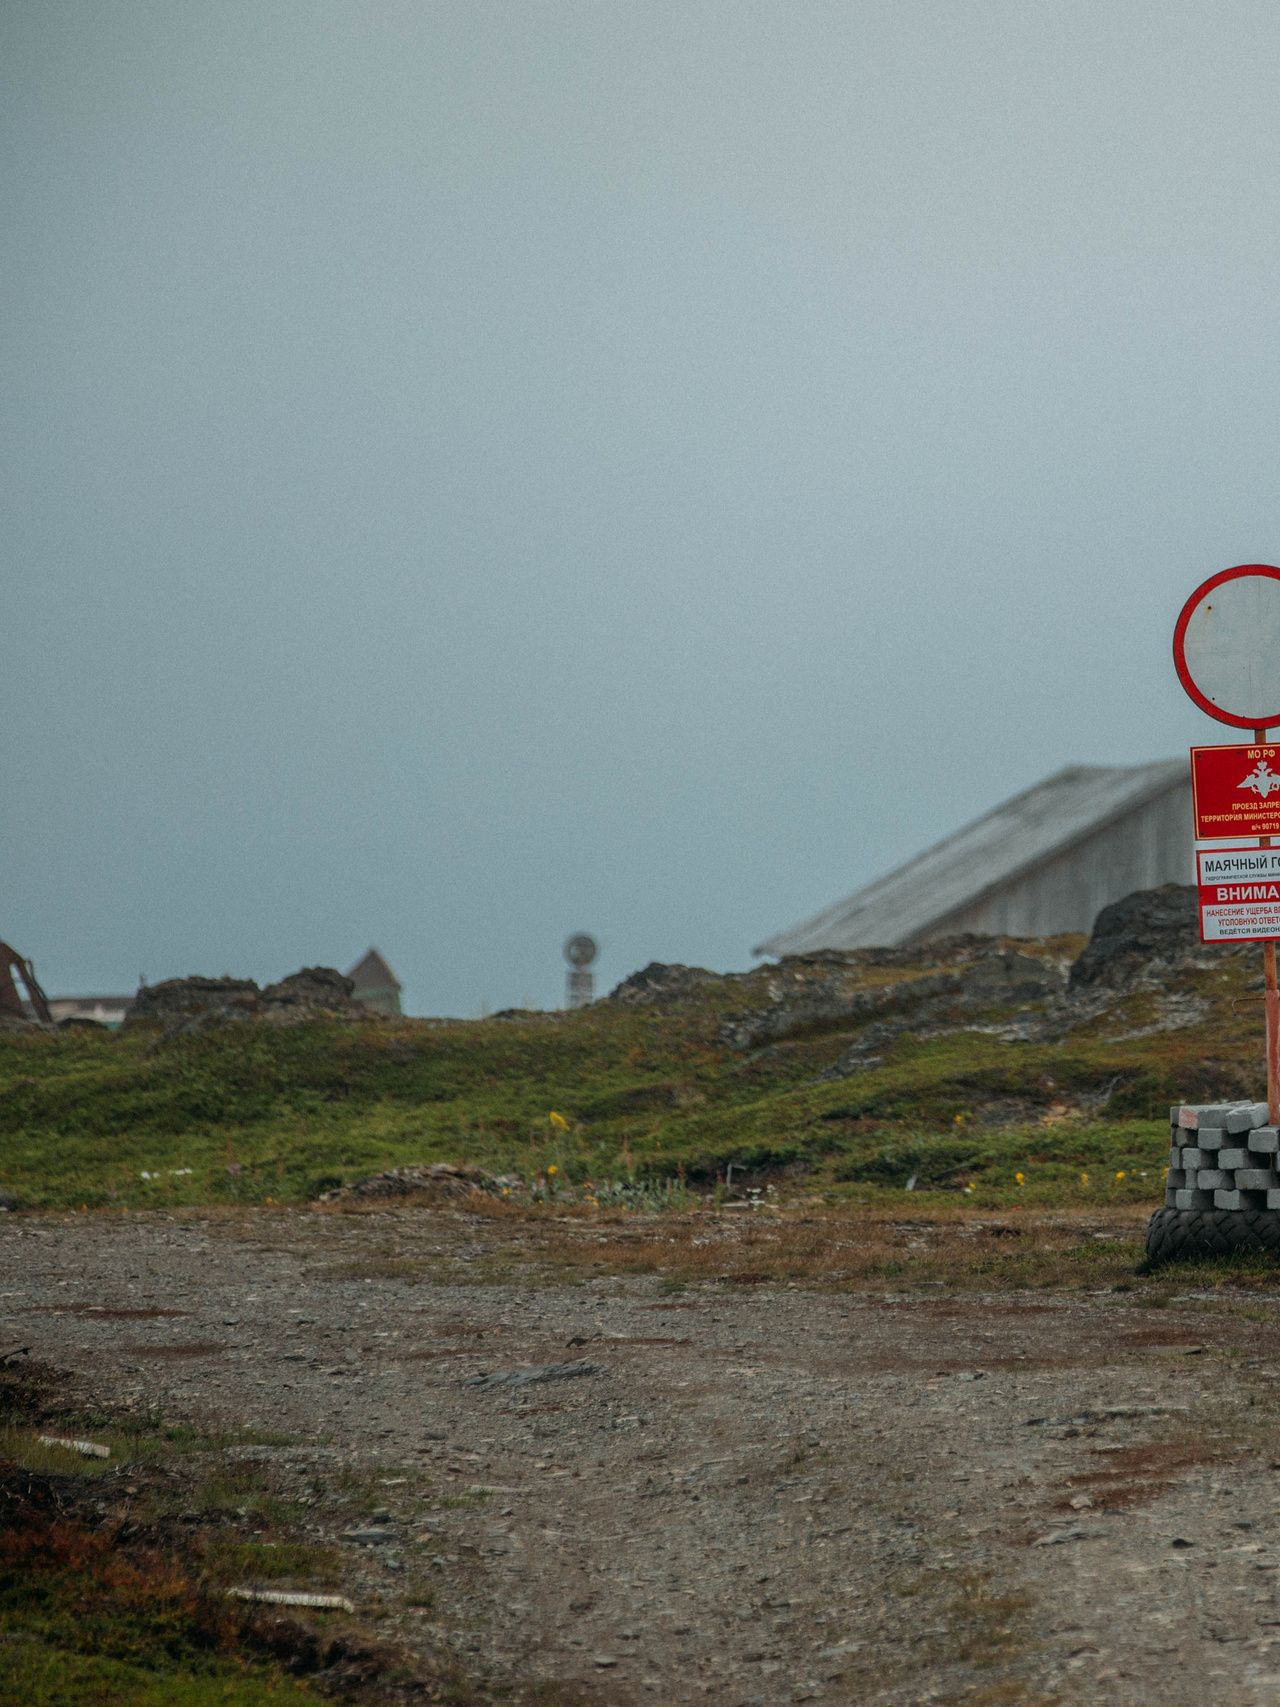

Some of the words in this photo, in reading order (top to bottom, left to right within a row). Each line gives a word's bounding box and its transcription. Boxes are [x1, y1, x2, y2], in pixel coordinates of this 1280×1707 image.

[1248, 750, 1261, 759] МО
[1263, 749, 1275, 758] РФ
[1232, 802, 1258, 810] ПРОЕЗД
[1201, 813, 1242, 822] ТЕРРИТОРИЯ
[1205, 855, 1267, 872] МАЯЧНЫЙ
[1206, 907, 1244, 917] НАНЕСЕНИЕ
[1246, 906, 1272, 915] УЩЕРБА
[1218, 916, 1258, 926] УГОЛОВНУЮ
